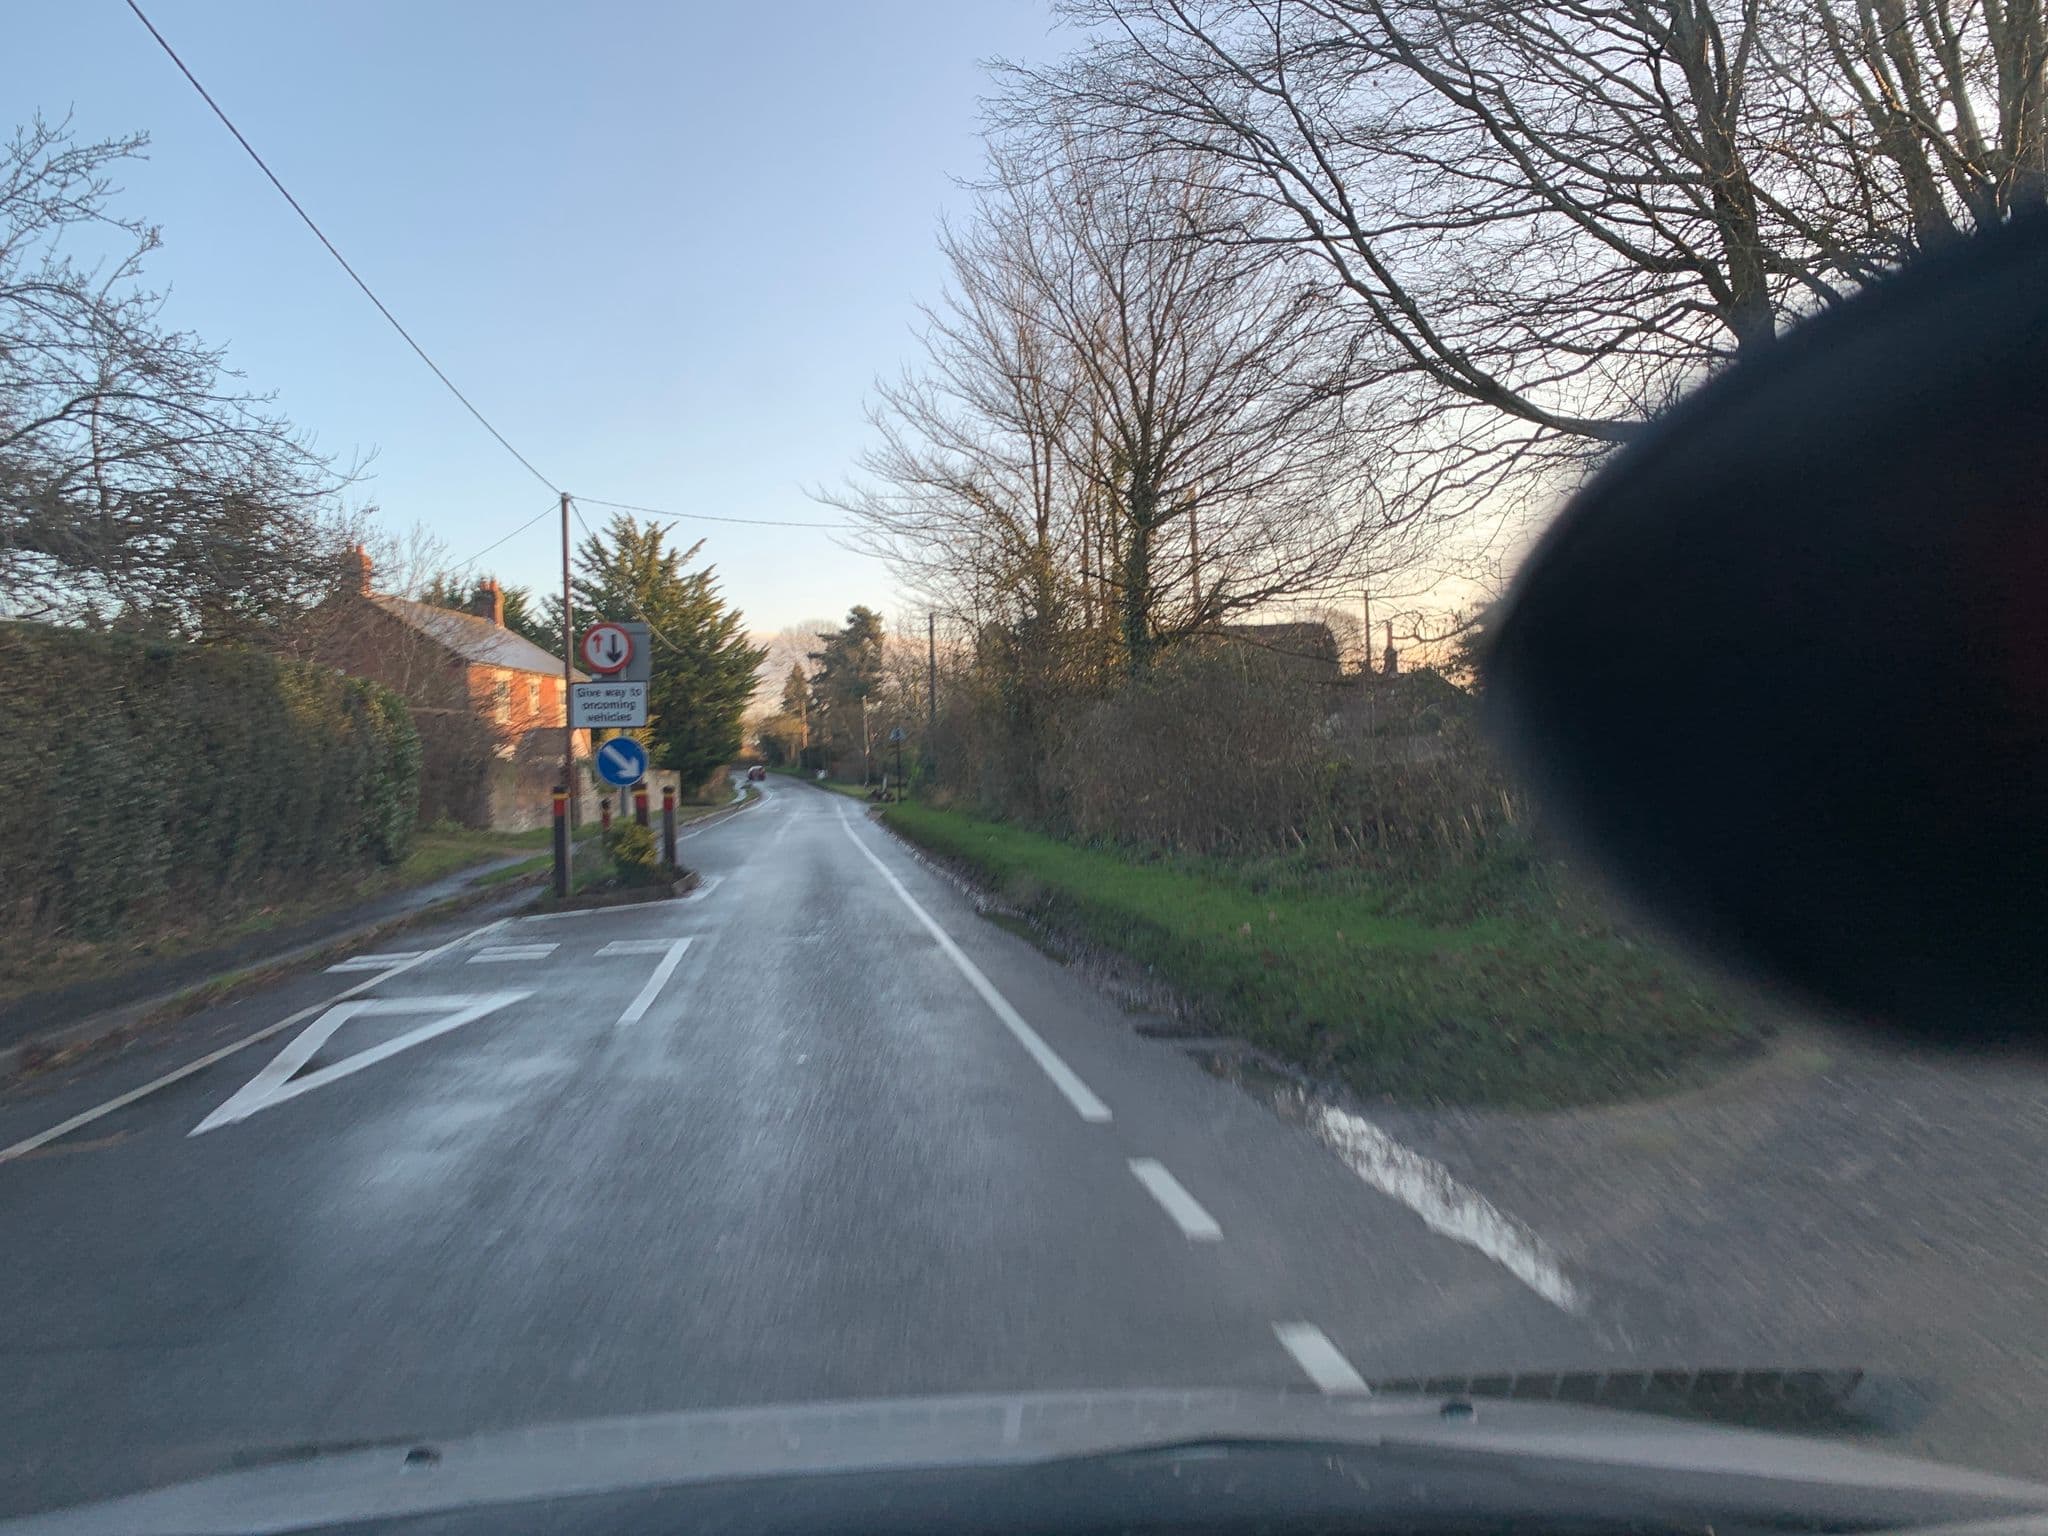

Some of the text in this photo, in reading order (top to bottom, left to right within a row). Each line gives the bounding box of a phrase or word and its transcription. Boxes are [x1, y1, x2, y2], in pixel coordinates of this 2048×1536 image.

[577, 687, 642, 698] Give way to
[582, 700, 636, 711] oncoming
[586, 712, 632, 722] vehicles
